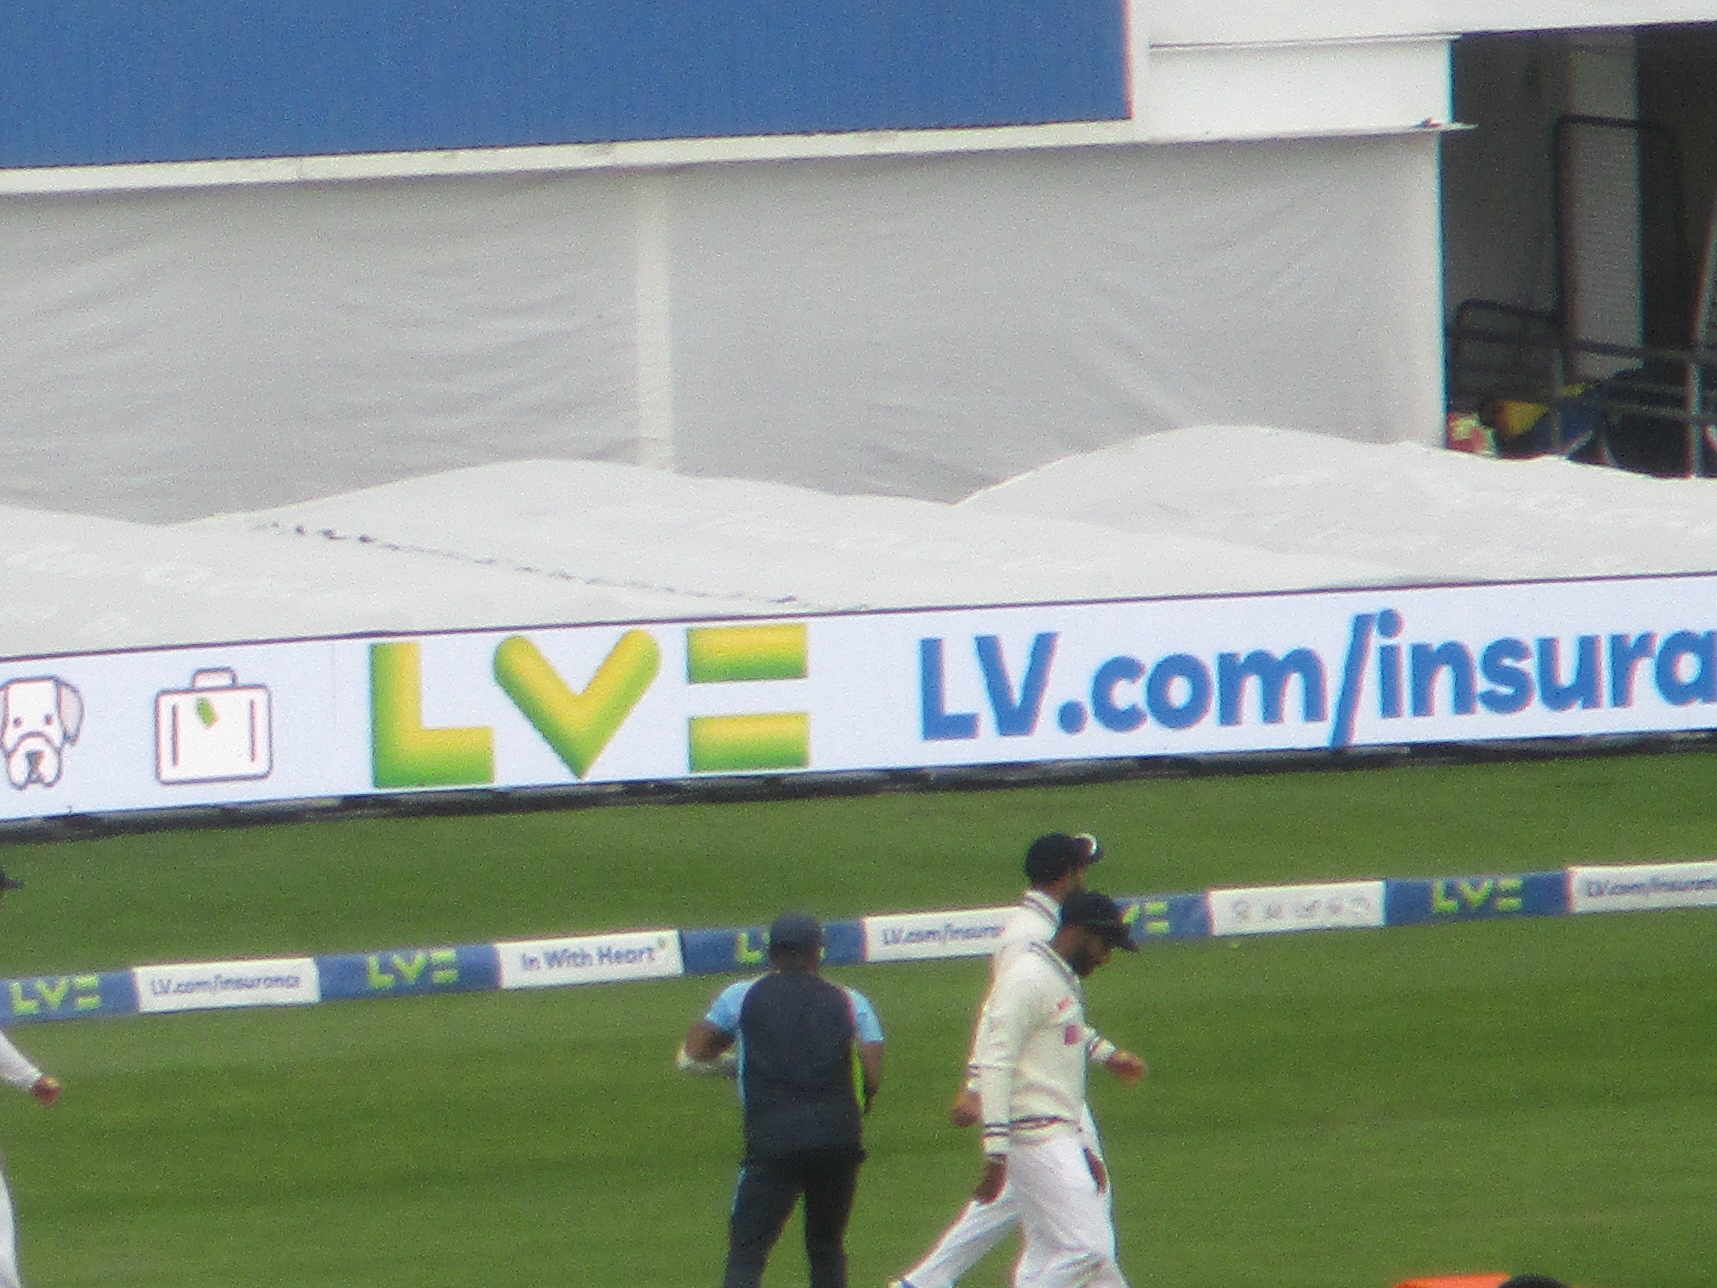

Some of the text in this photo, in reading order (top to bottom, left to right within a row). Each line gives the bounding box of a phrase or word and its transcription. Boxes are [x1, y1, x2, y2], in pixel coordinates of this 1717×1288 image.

[918, 608, 1717, 749] LV.com/insura
[520, 945, 655, 971] In With Heart
